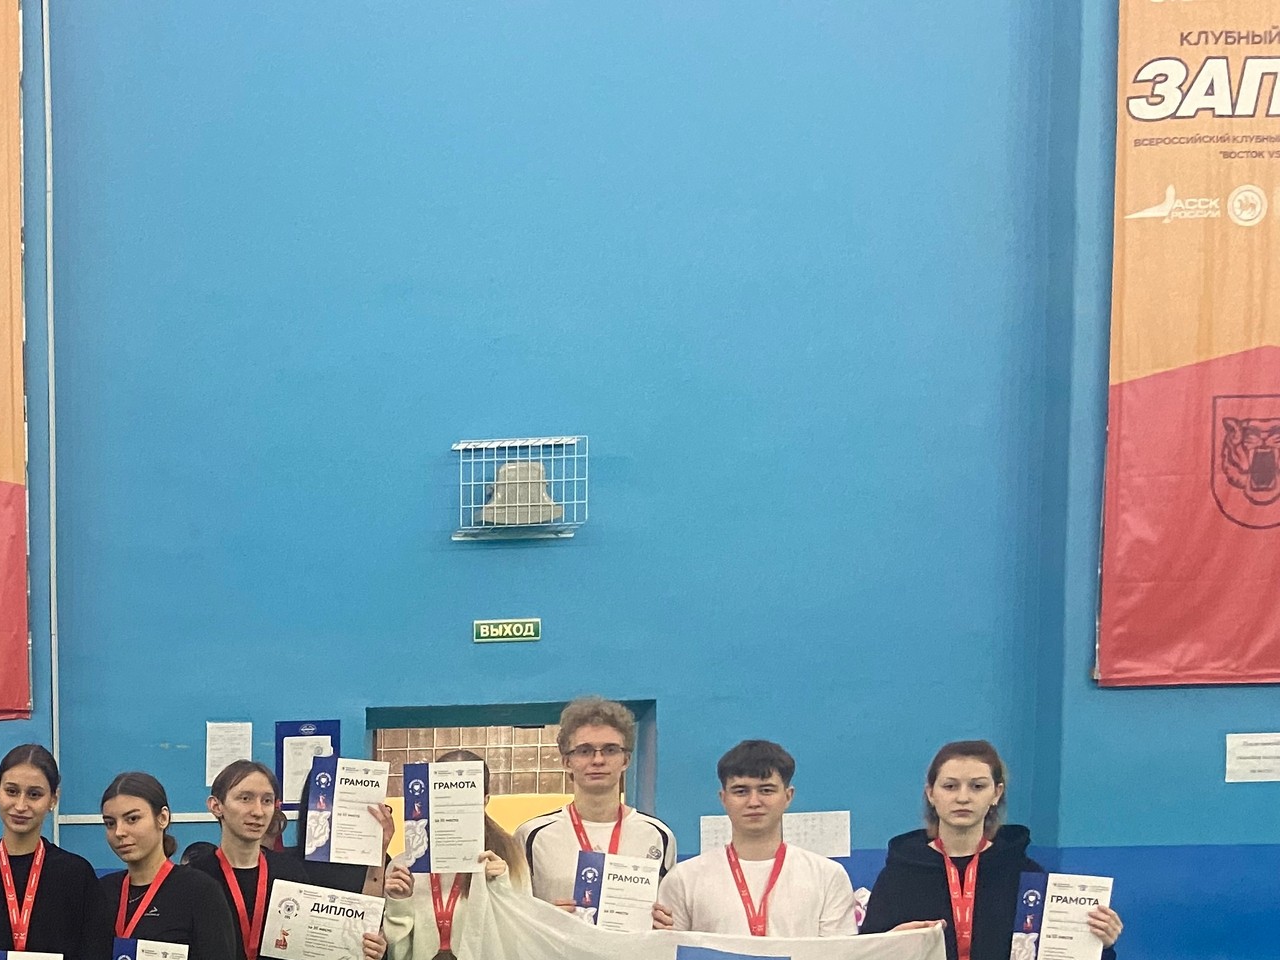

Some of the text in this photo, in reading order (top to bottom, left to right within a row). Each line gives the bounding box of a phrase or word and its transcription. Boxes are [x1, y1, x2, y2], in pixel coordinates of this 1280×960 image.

[1133, 133, 1231, 147] ВСЕРОССИЙСКИЙ
[1171, 198, 1220, 210] АССК
[480, 623, 535, 637] ВЫХОД
[339, 777, 381, 789] ГРАМОТА
[433, 781, 477, 790] ГРАМОТА
[607, 873, 651, 886] ГРАМОТА
[1050, 895, 1100, 906] ГРАМОТА
[310, 902, 366, 920] ДИПЛОМ
